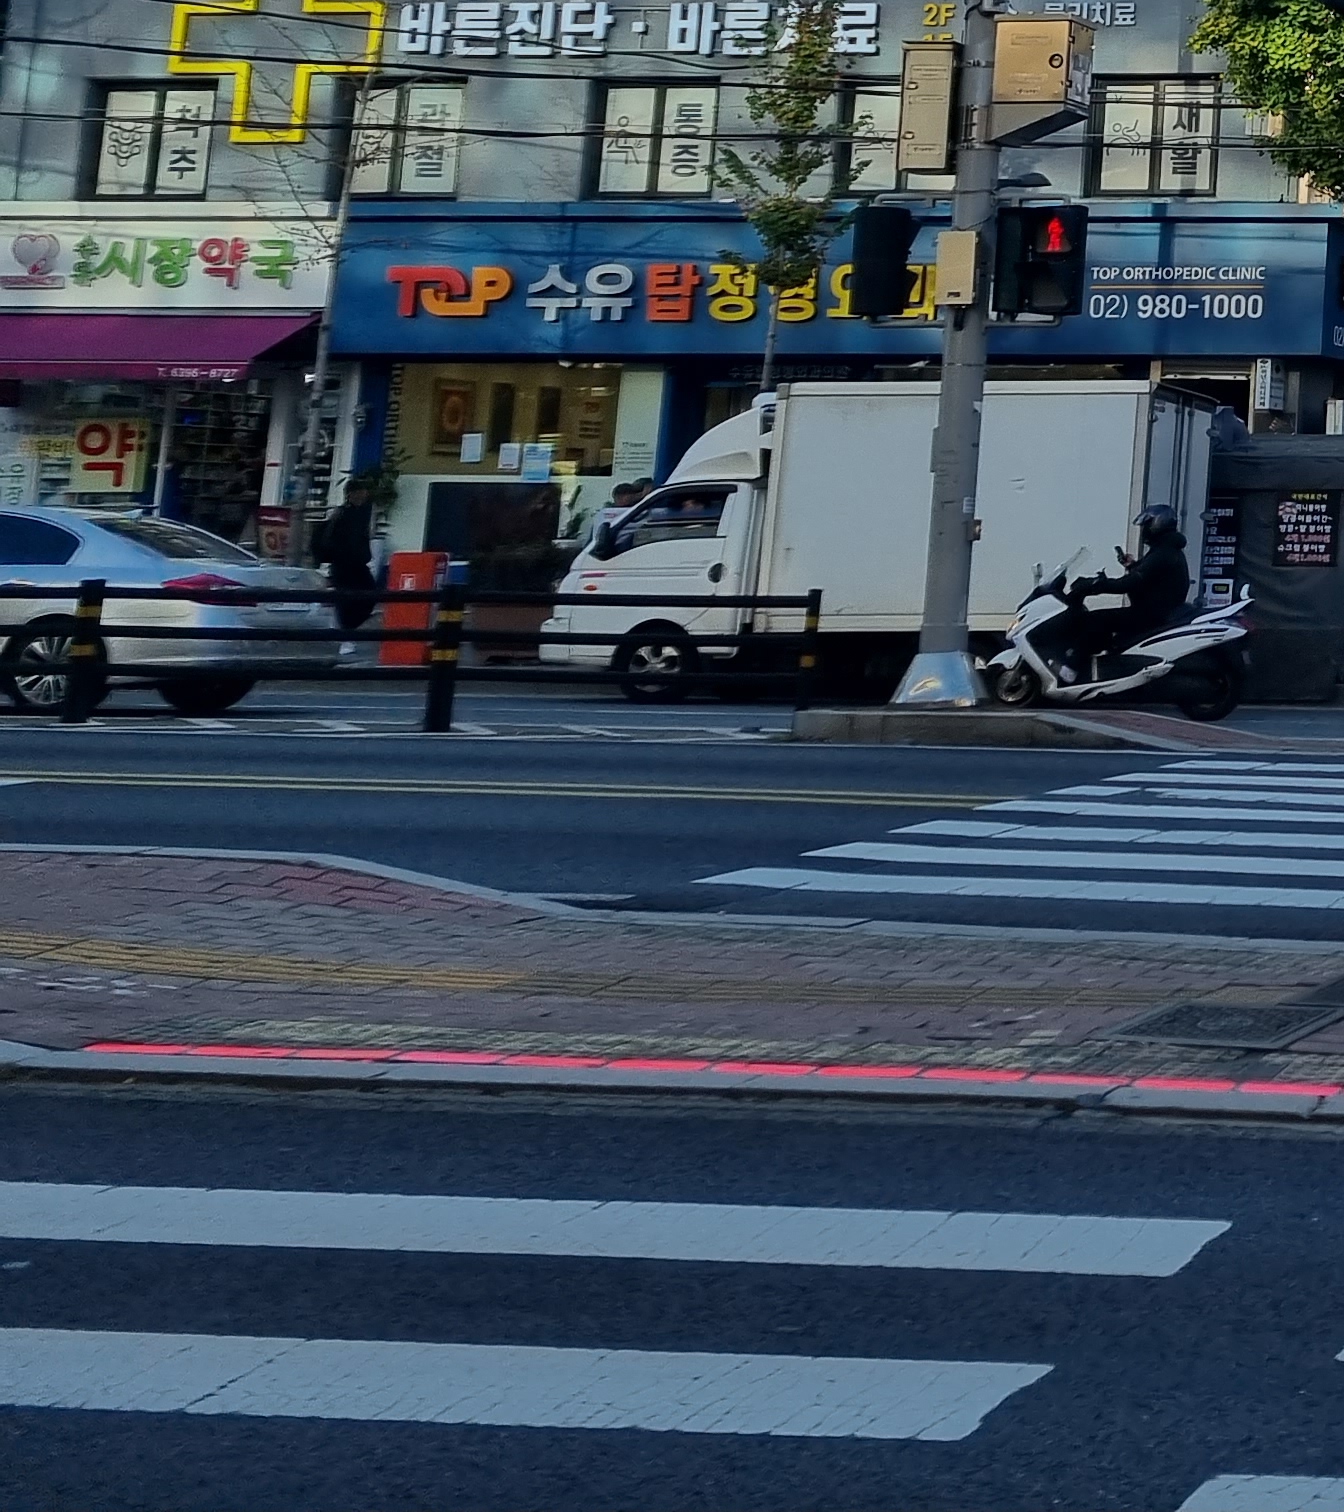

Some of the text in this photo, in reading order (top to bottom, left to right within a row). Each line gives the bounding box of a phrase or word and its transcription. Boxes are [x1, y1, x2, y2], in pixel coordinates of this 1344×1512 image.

[399, 0, 615, 56] 바른진단
[923, 3, 956, 26] 2F
[386, 263, 512, 317] TOP
[1091, 265, 1266, 281] TOP ORTHOPEDIC CLINIC
[1089, 294, 1264, 320] 02) 980-1000
[76, 422, 145, 487] 약
